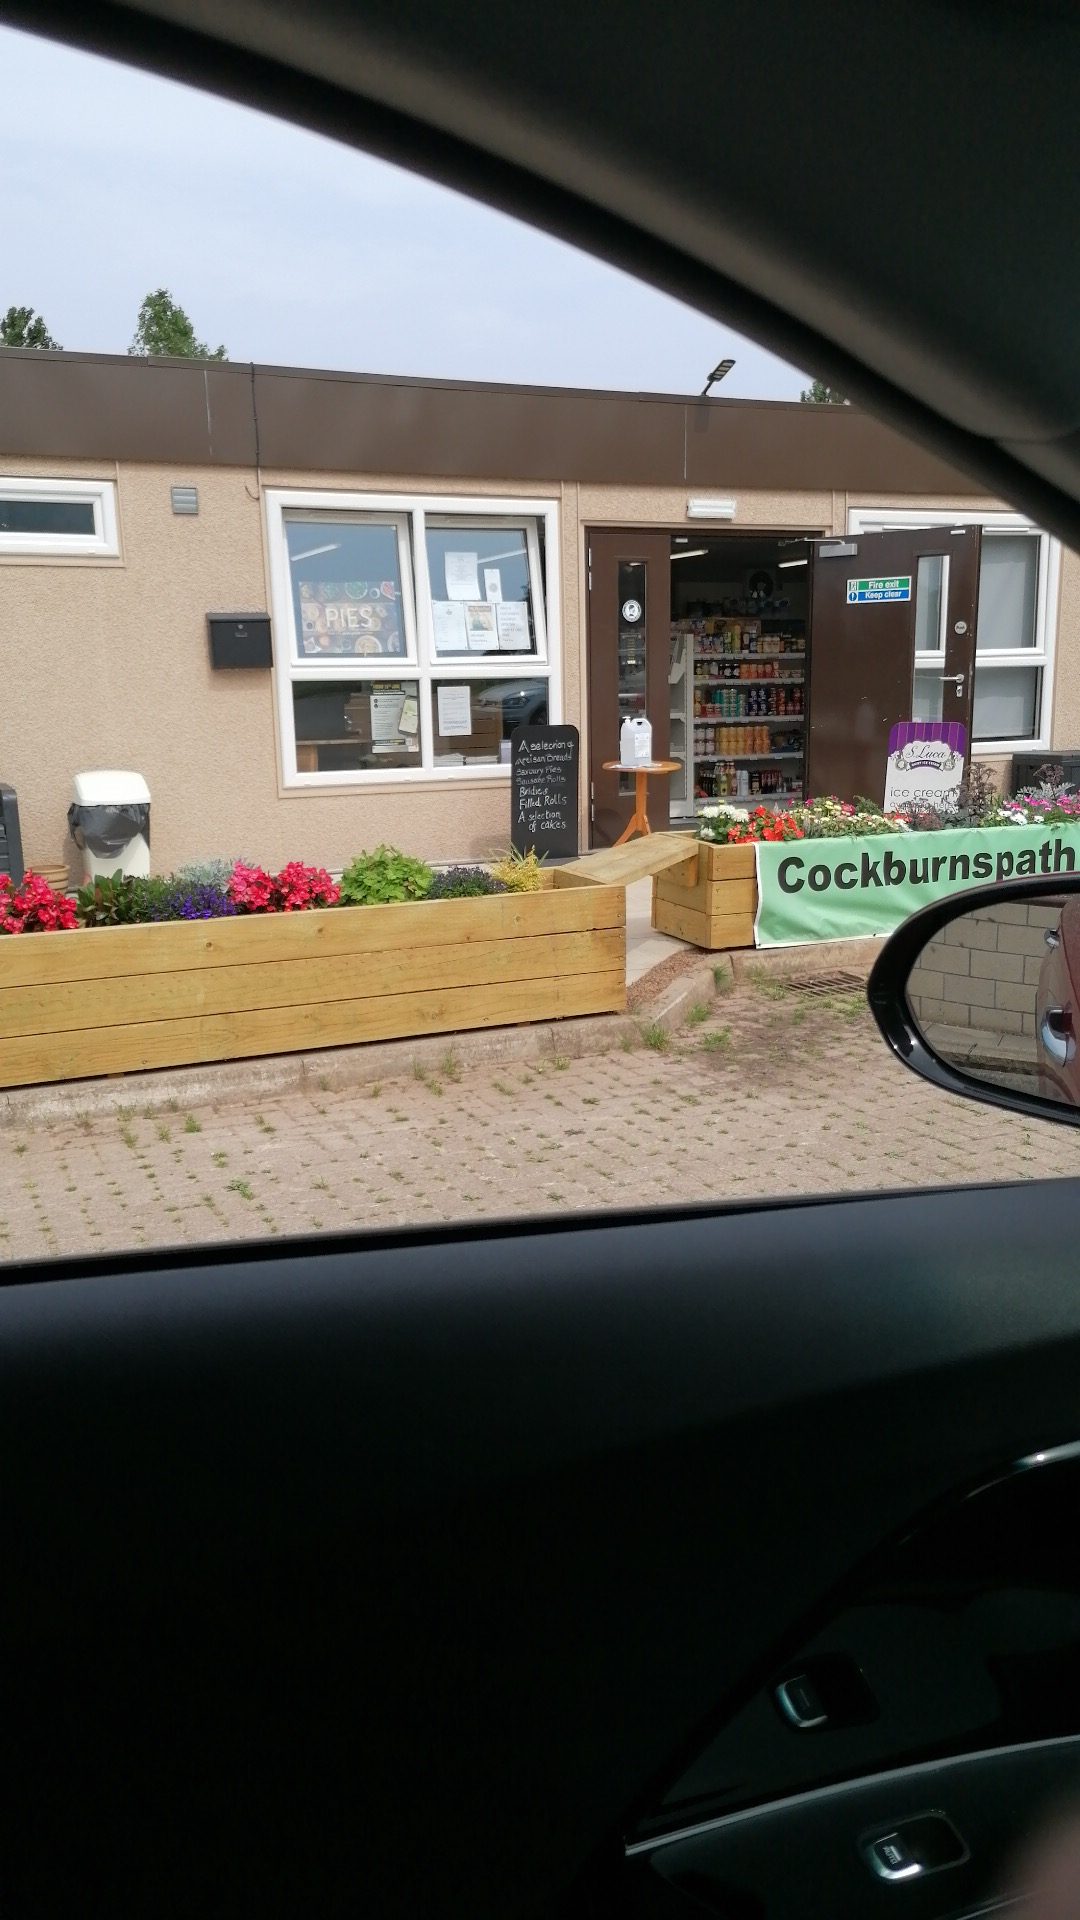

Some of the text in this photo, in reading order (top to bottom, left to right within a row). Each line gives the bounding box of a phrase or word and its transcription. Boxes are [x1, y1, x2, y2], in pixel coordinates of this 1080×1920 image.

[868, 580, 899, 589] Fire exit
[865, 592, 883, 600] Keep
[325, 608, 373, 628] PIES
[518, 740, 530, 753] A
[890, 786, 955, 799] ice cream
[519, 793, 568, 810] Filled Rolls
[518, 810, 562, 823] A selection
[528, 819, 567, 833] of cakes
[777, 839, 1076, 894] Cockburnspath
